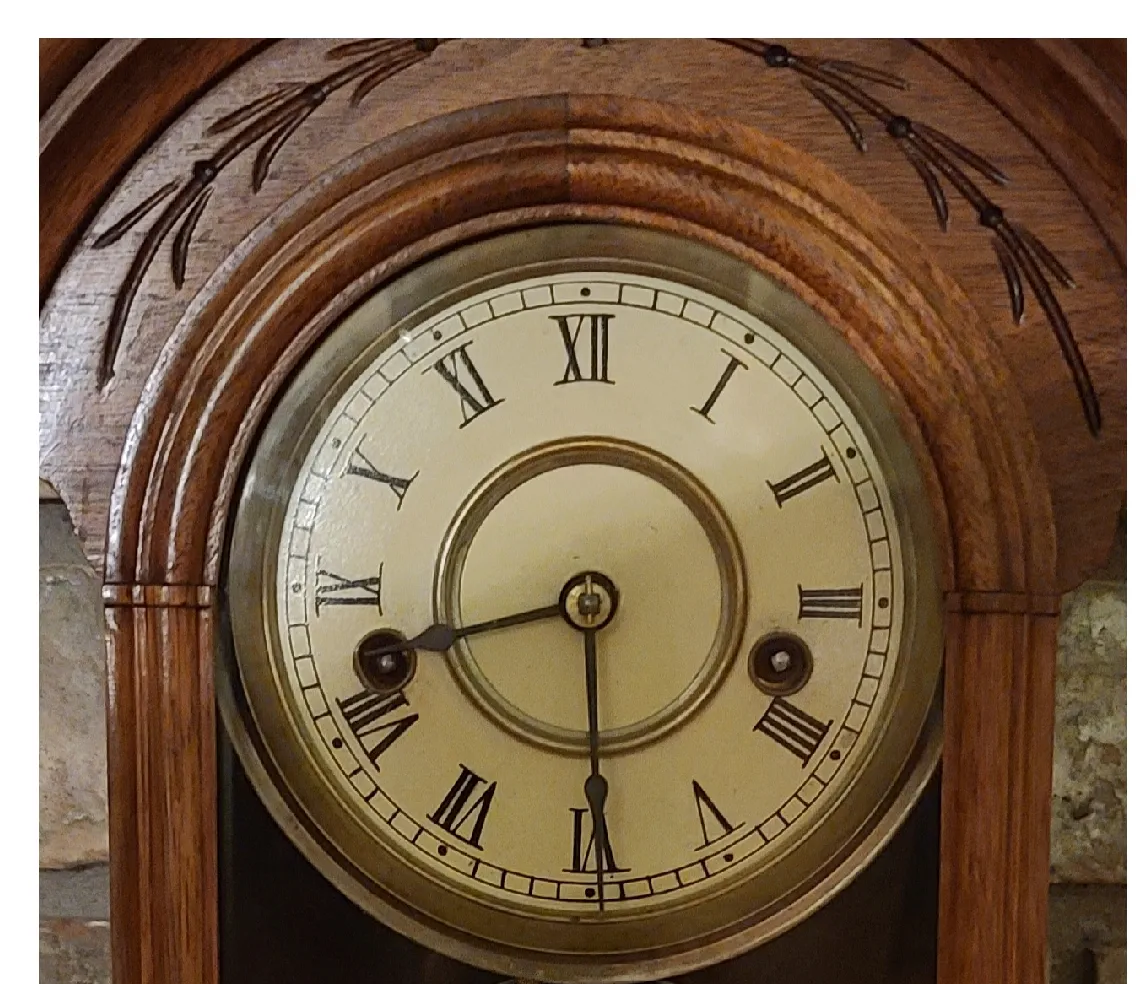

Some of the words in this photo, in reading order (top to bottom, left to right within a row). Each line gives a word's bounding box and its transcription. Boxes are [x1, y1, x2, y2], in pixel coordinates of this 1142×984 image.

[421, 340, 505, 429] XI
[548, 314, 615, 386] XII
[690, 348, 748, 424] I
[340, 433, 420, 511] X
[766, 445, 840, 509] II
[315, 555, 384, 617] IX
[798, 582, 863, 628] III
[426, 763, 497, 851] VII
[562, 807, 632, 874] VI
[692, 779, 746, 852] V
